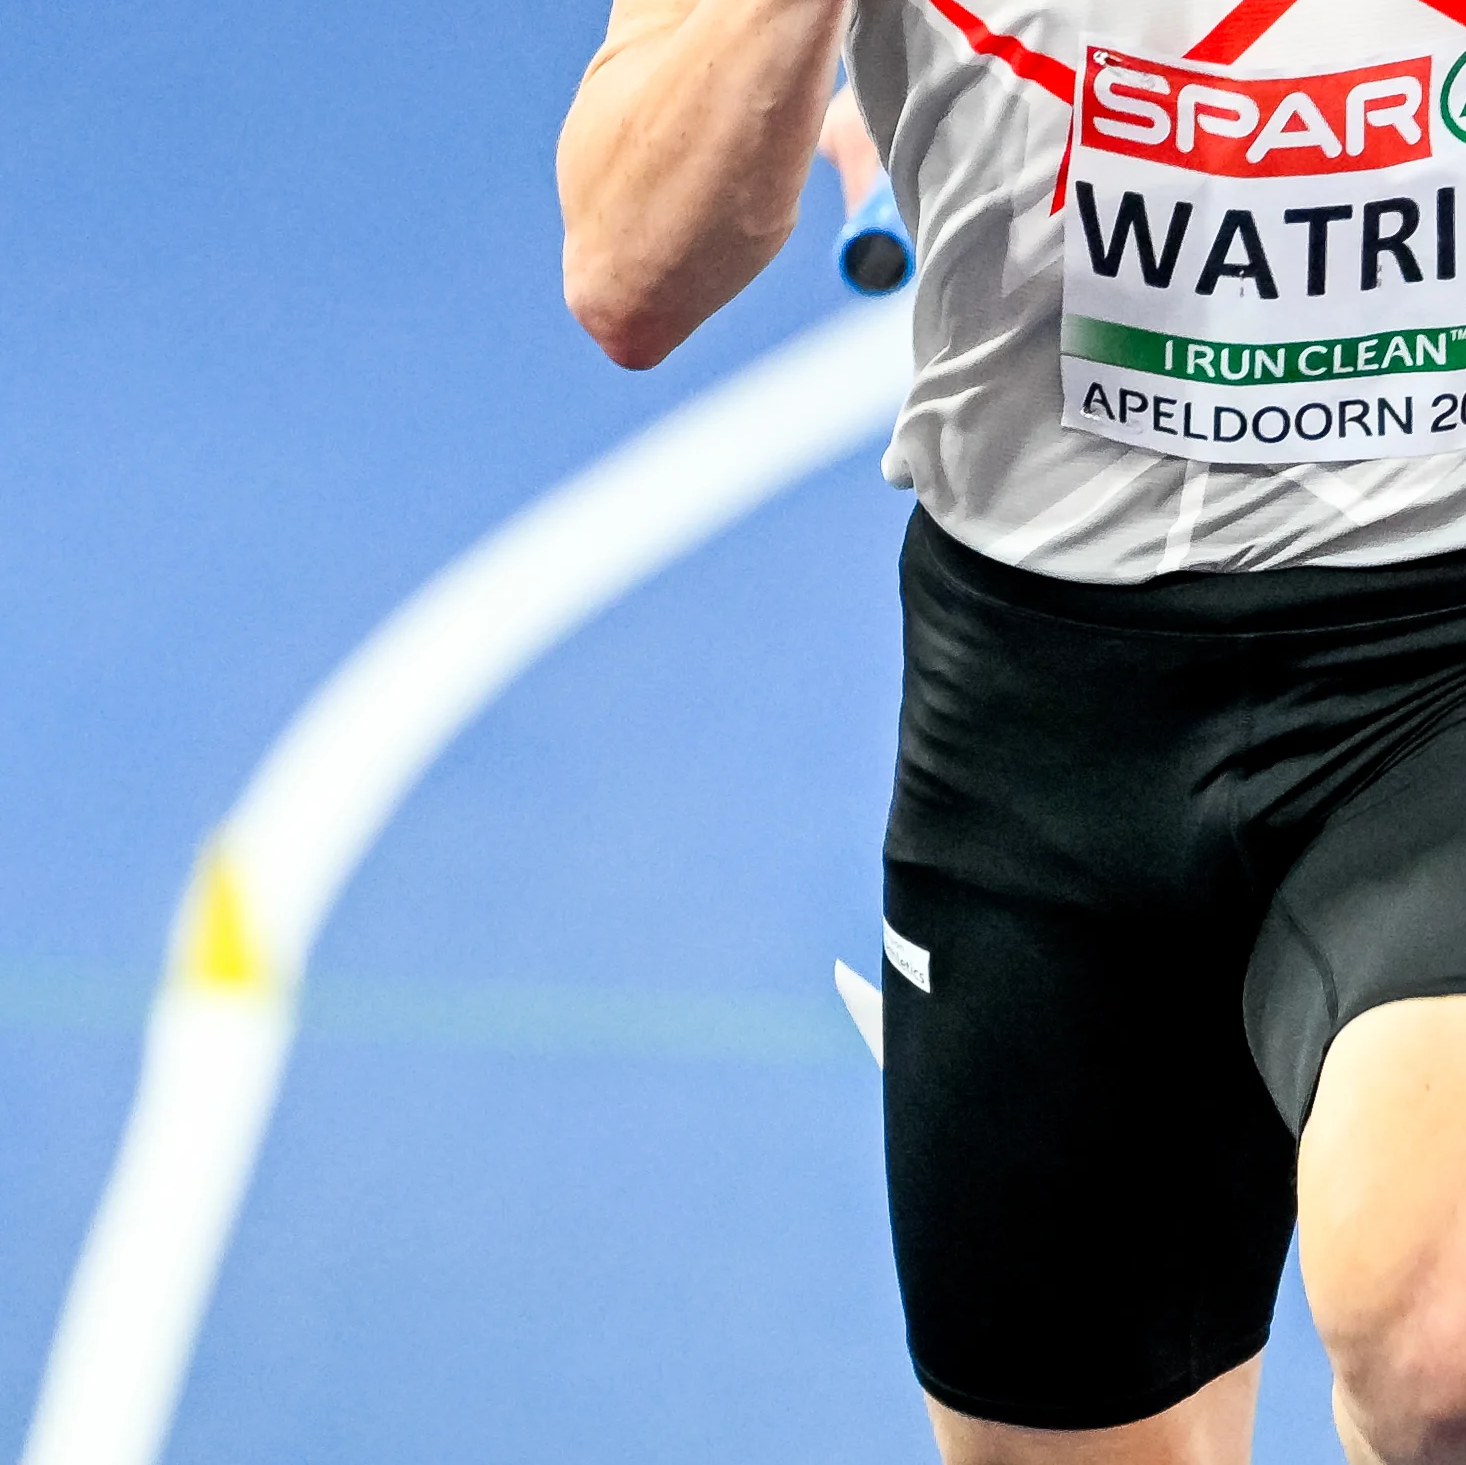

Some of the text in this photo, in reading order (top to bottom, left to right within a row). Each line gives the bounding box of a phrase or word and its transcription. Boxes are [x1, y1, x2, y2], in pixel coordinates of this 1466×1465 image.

[1093, 68, 1424, 164] SPAR
[1164, 339, 1174, 371] I
[1186, 343, 1286, 381] RUN
[1082, 380, 1413, 445] APELDOORN
